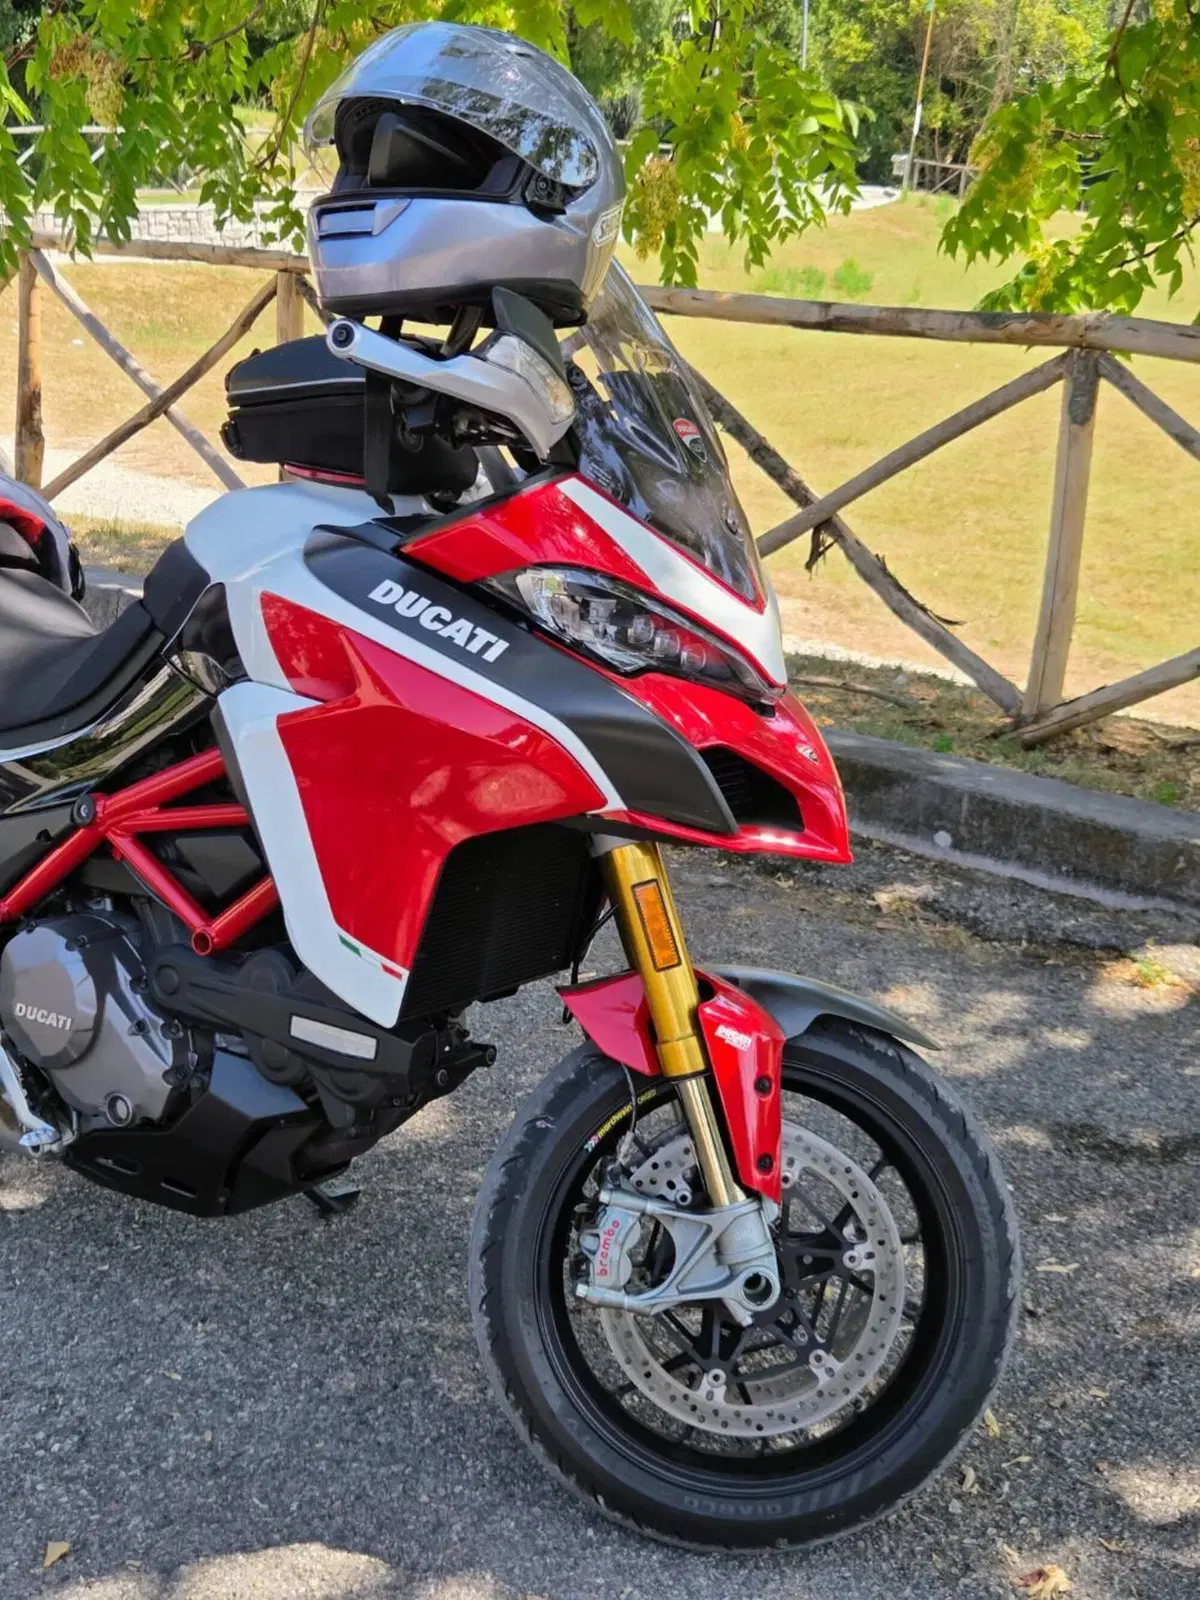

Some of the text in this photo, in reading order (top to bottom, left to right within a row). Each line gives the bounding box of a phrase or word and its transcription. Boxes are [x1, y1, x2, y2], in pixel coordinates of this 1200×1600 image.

[367, 578, 510, 664] DUCATI
[14, 1002, 72, 1031] DUCATI
[596, 1219, 621, 1277] brembo
